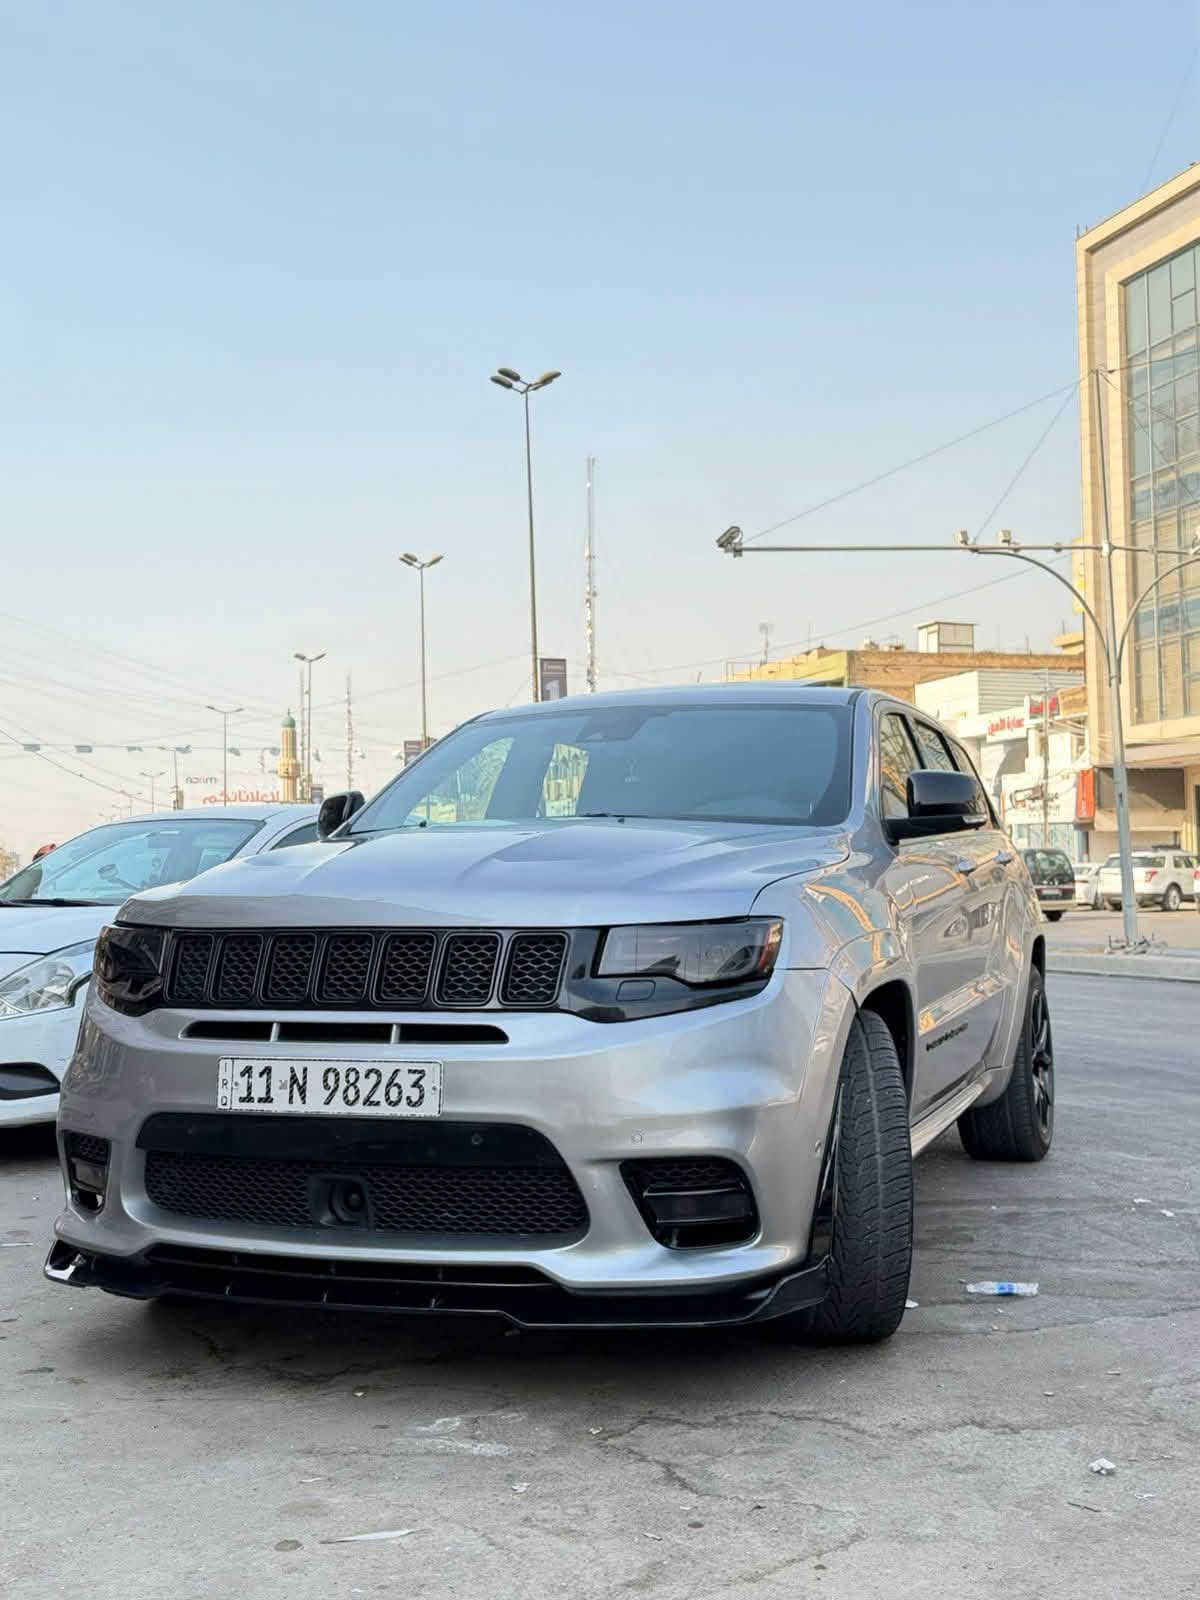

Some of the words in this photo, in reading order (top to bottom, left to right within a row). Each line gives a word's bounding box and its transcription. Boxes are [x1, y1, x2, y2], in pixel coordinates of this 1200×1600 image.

[239, 1065, 274, 1104] 11
[288, 1066, 308, 1105] N
[322, 1067, 426, 1107] 98263
